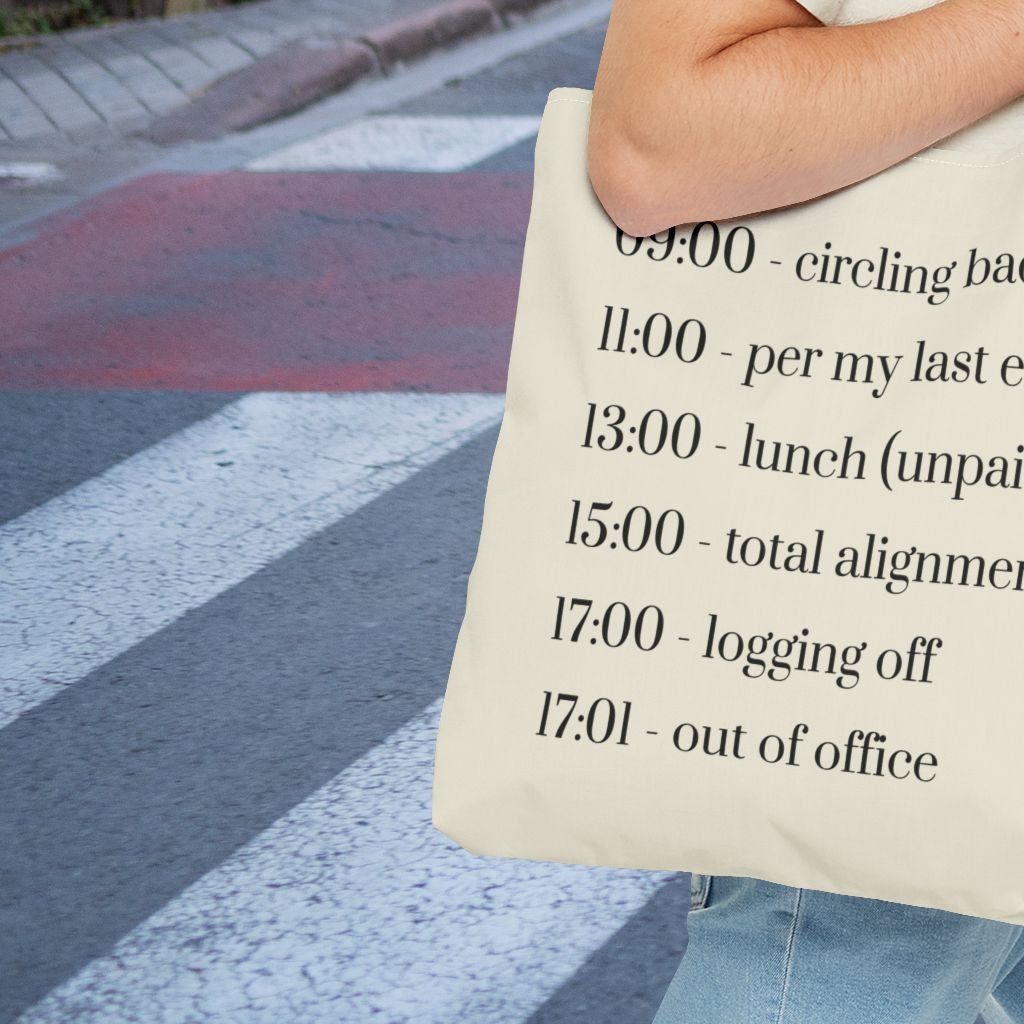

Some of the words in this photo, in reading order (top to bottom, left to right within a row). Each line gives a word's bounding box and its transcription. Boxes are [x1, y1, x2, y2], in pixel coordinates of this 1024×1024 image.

[795, 241, 958, 306] circling
[597, 305, 707, 364] 11:00
[741, 344, 823, 388] per
[831, 351, 904, 399] my
[910, 340, 989, 384] last
[581, 402, 701, 459] 13:00
[738, 422, 866, 480] lunch
[565, 499, 685, 556] 15:00
[726, 528, 825, 575] total
[551, 595, 664, 652] 17:00
[702, 613, 868, 690] logging
[876, 636, 943, 684] off
[535, 690, 632, 746] 17:01
[672, 723, 747, 760] out
[758, 723, 809, 767] of
[814, 729, 938, 783] office
